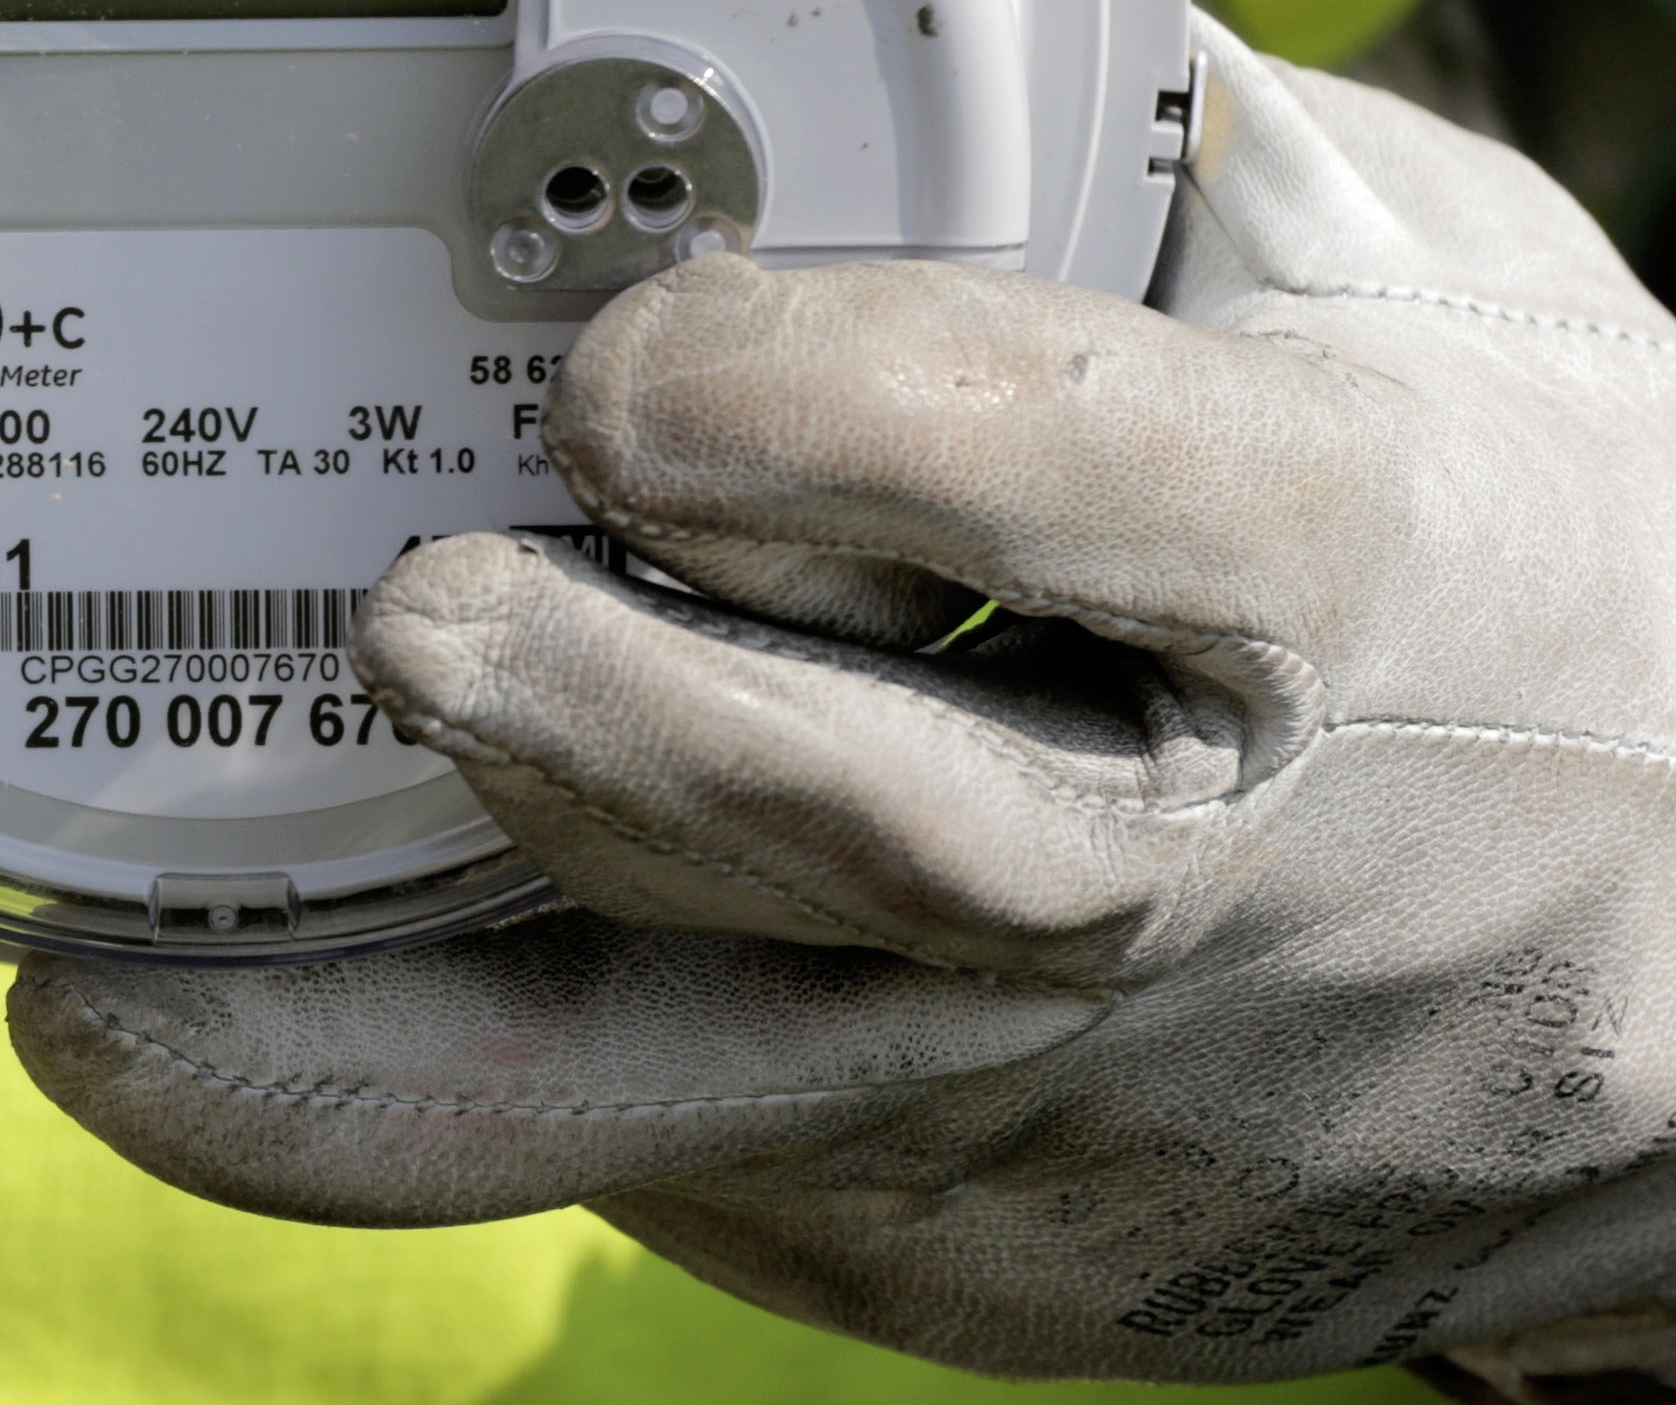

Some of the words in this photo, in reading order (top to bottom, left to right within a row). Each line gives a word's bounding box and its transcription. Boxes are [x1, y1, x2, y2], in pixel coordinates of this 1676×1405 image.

[0, 366, 82, 388] Meter
[469, 355, 512, 385] 58
[142, 407, 258, 443] 240V
[348, 406, 422, 441] 3W
[142, 451, 226, 476] 60HZ
[257, 450, 301, 475] TA
[313, 449, 350, 475] 30
[383, 449, 418, 474] Kt
[430, 447, 475, 474] 1.0
[20, 653, 343, 685] CPGG270007670
[26, 696, 144, 751] 270
[167, 695, 283, 750] 007
